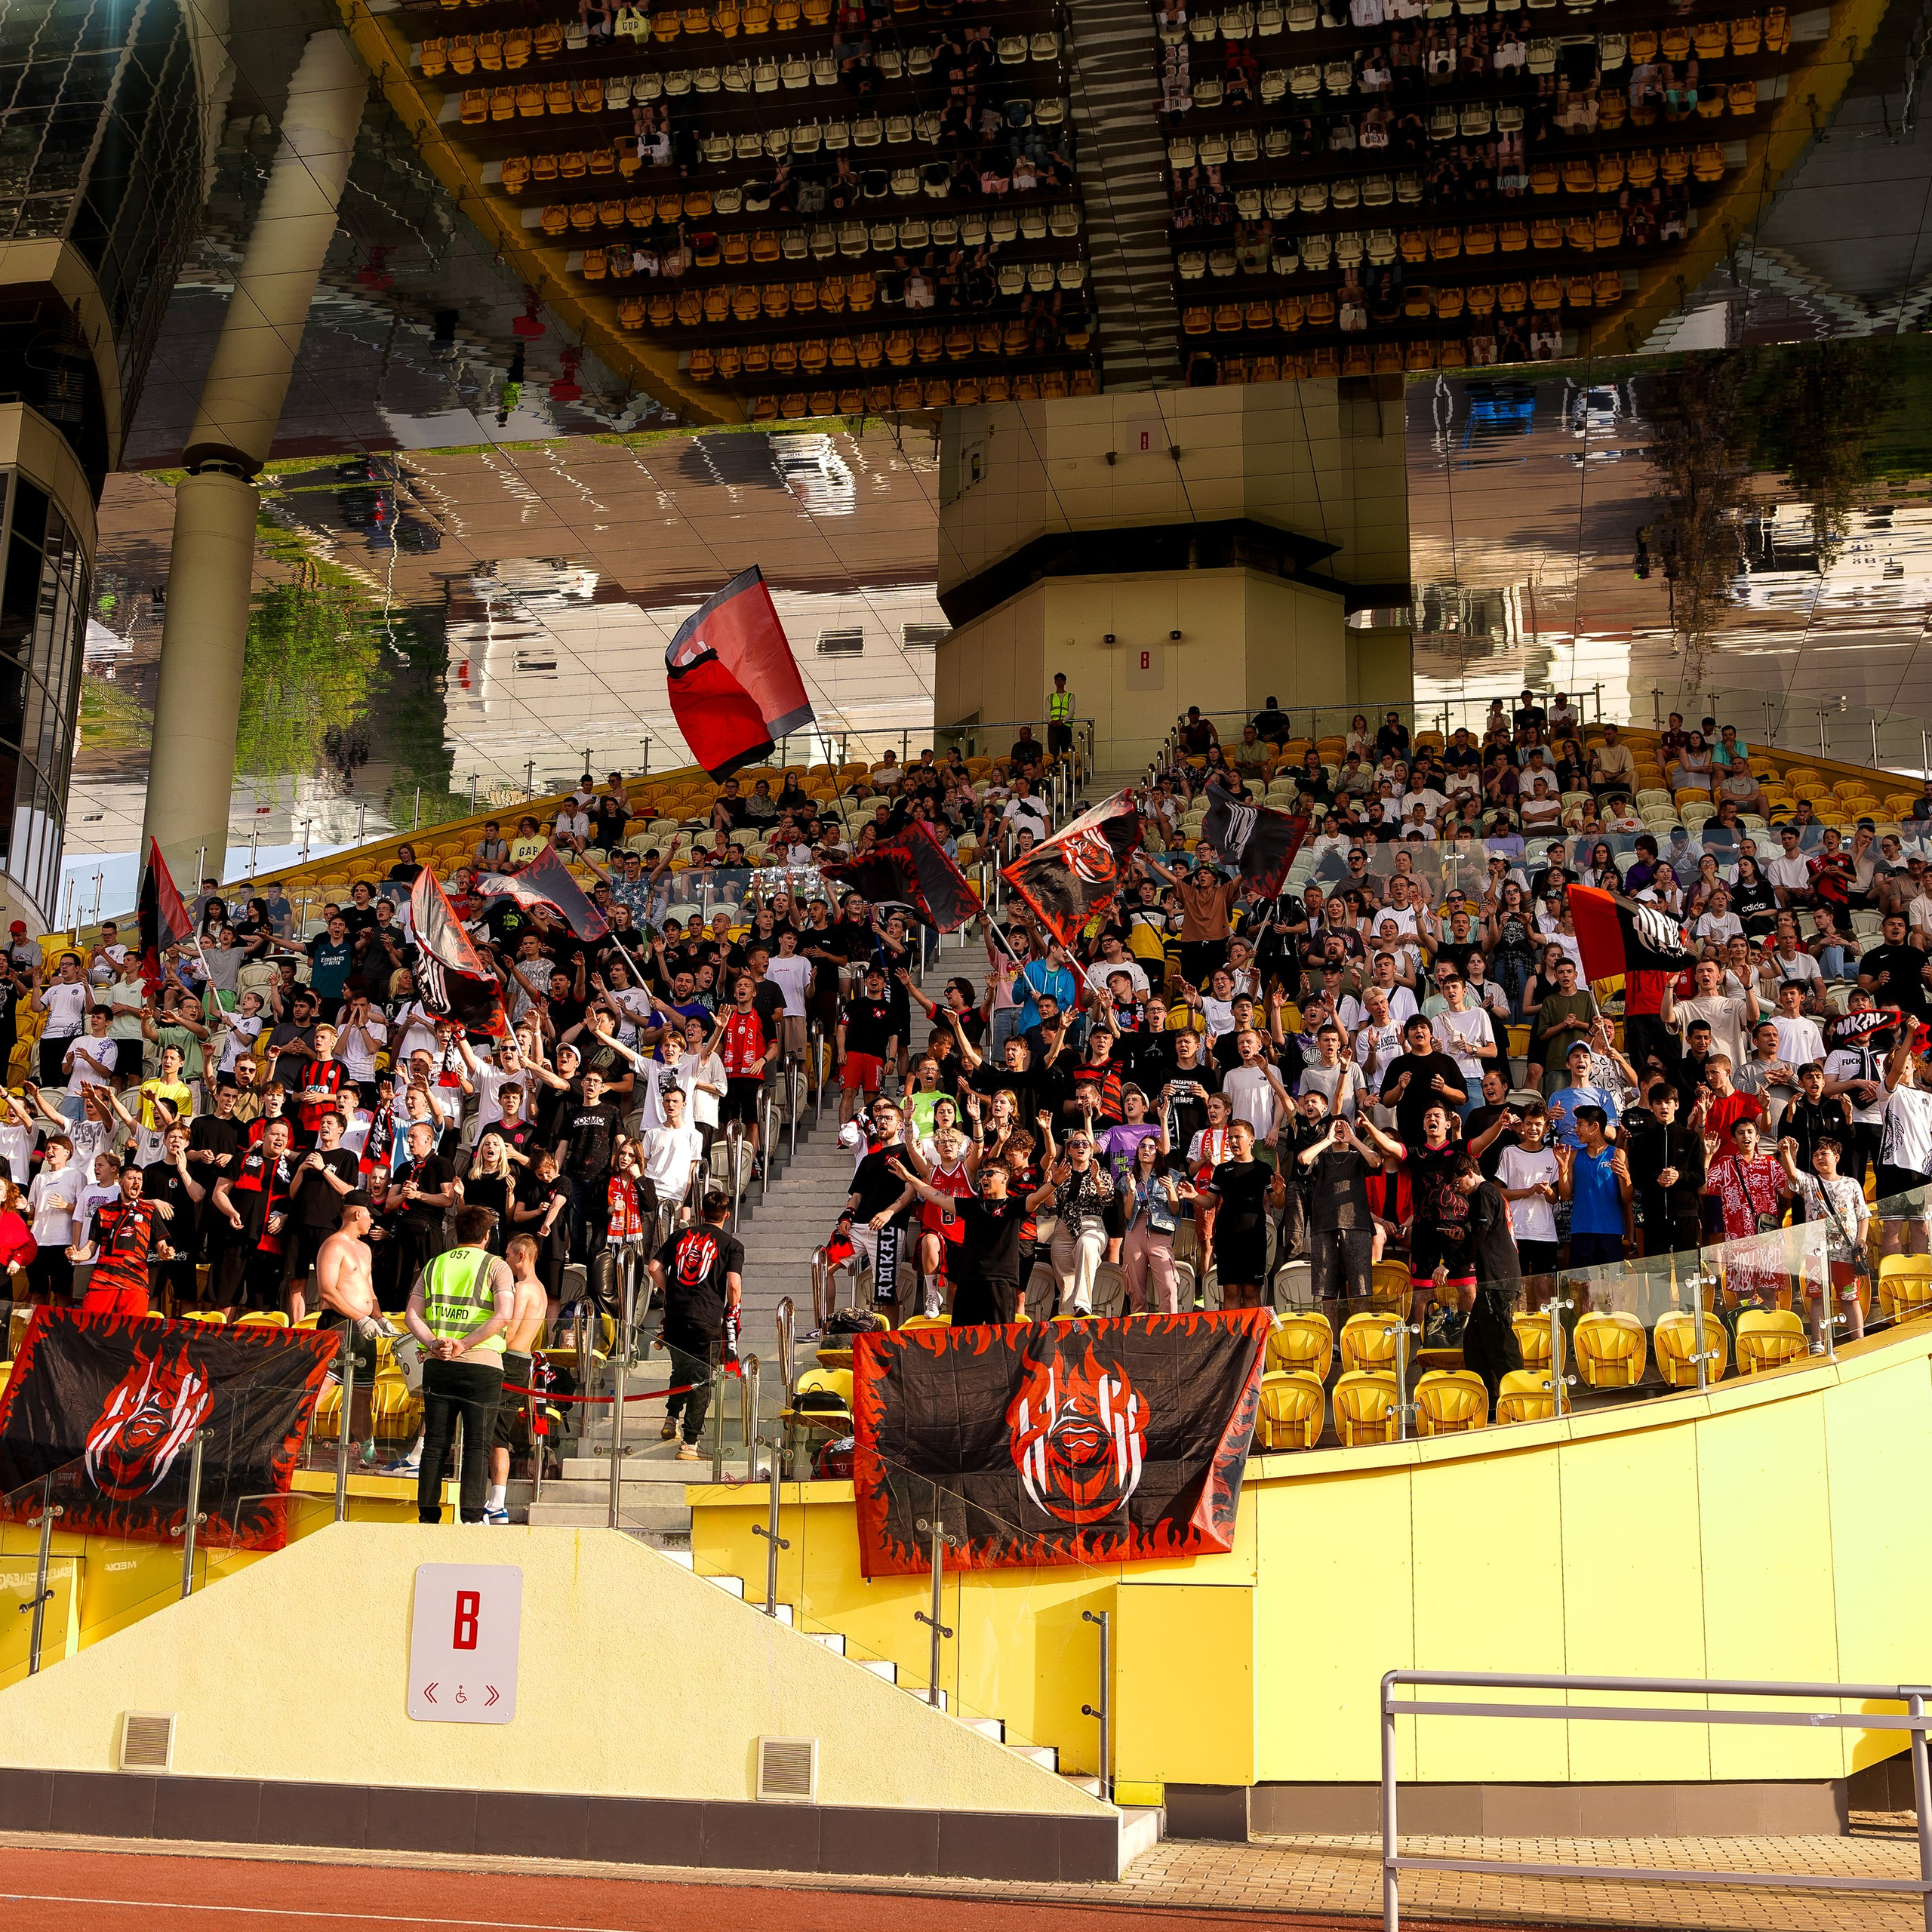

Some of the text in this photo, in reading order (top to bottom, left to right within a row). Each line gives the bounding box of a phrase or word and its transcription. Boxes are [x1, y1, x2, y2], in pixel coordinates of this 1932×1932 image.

[1140, 651, 1150, 669] B
[519, 846, 538, 857] GAP
[1742, 902, 1766, 912] adidas
[1836, 1012, 1887, 1035] MKAL
[450, 1250, 469, 1260] 057
[878, 1226, 896, 1298] AMKAL
[431, 1305, 469, 1320] TWARD
[453, 1590, 480, 1651] B
